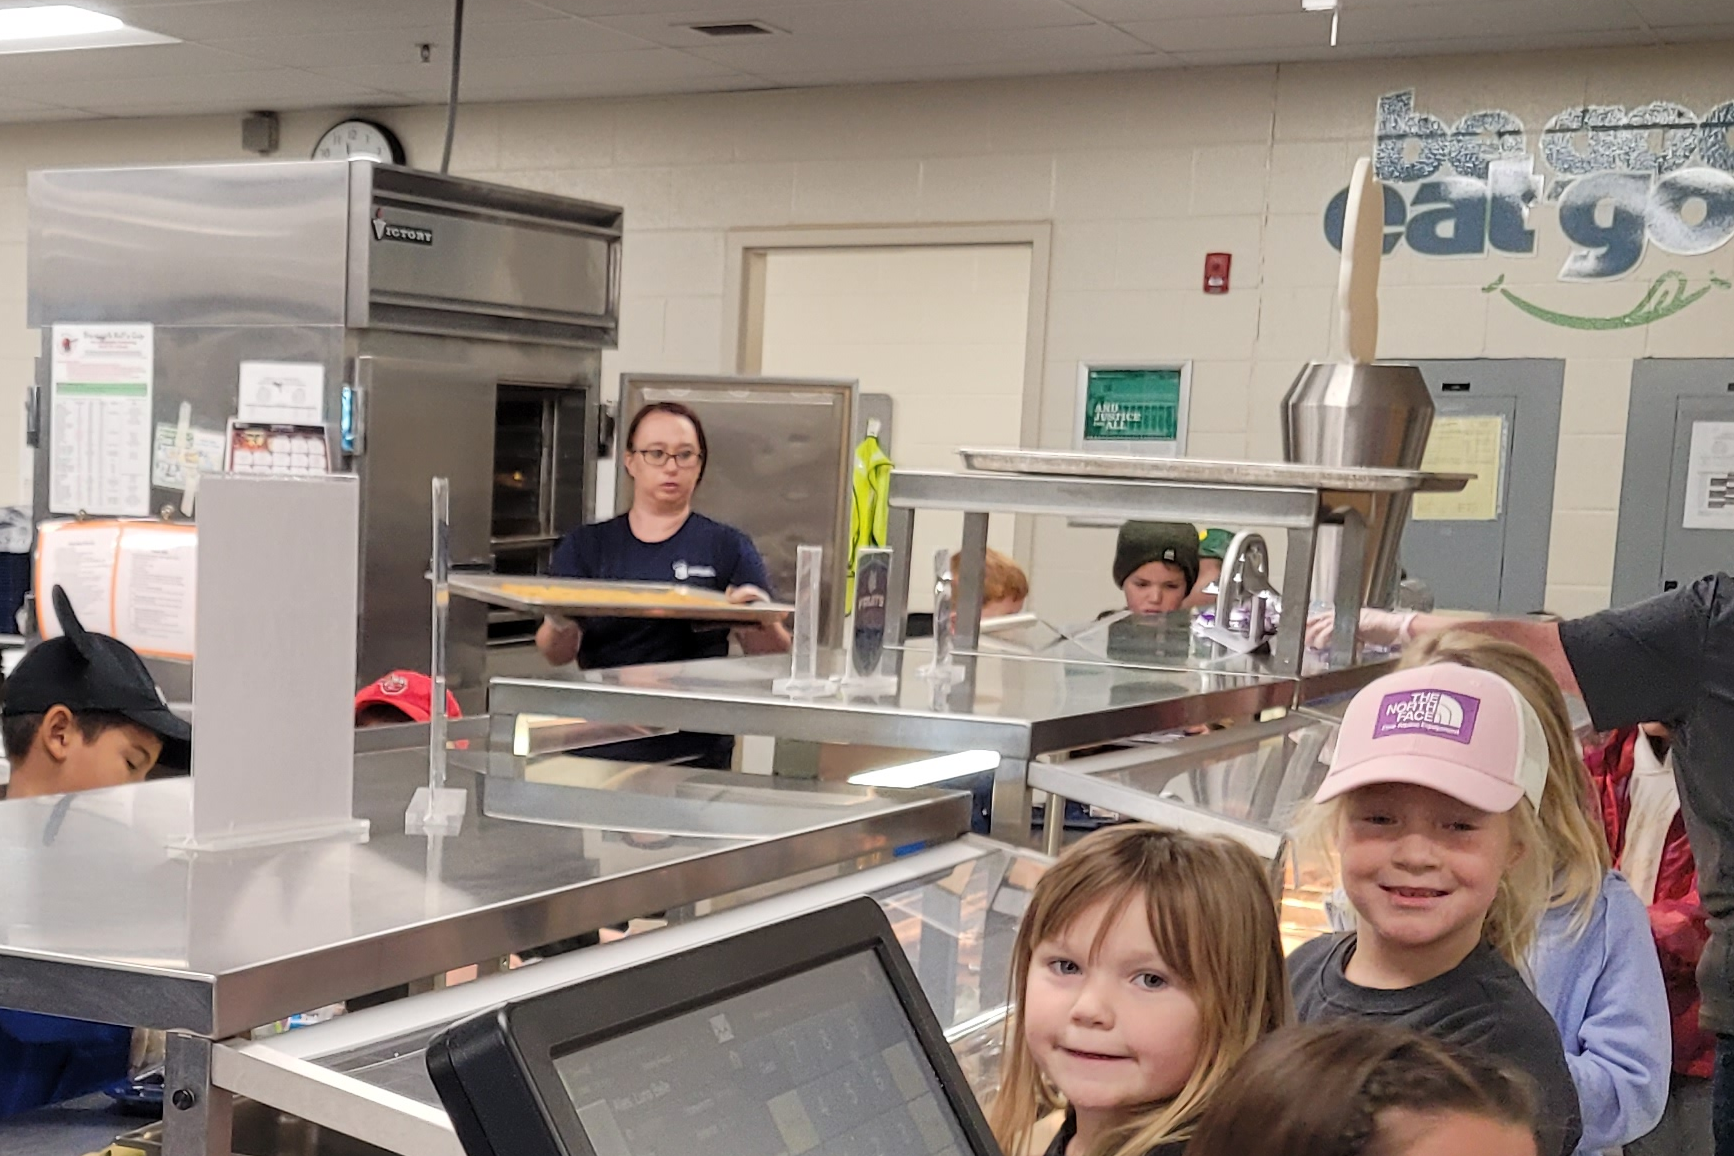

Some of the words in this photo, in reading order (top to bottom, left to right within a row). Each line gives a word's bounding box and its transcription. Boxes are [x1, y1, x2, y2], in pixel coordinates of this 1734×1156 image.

[371, 219, 432, 242] VICTORY
[1093, 412, 1142, 423] JUSTICE
[1410, 691, 1441, 703] THE
[1386, 701, 1437, 717] NORTH
[1396, 710, 1435, 723] FACE
